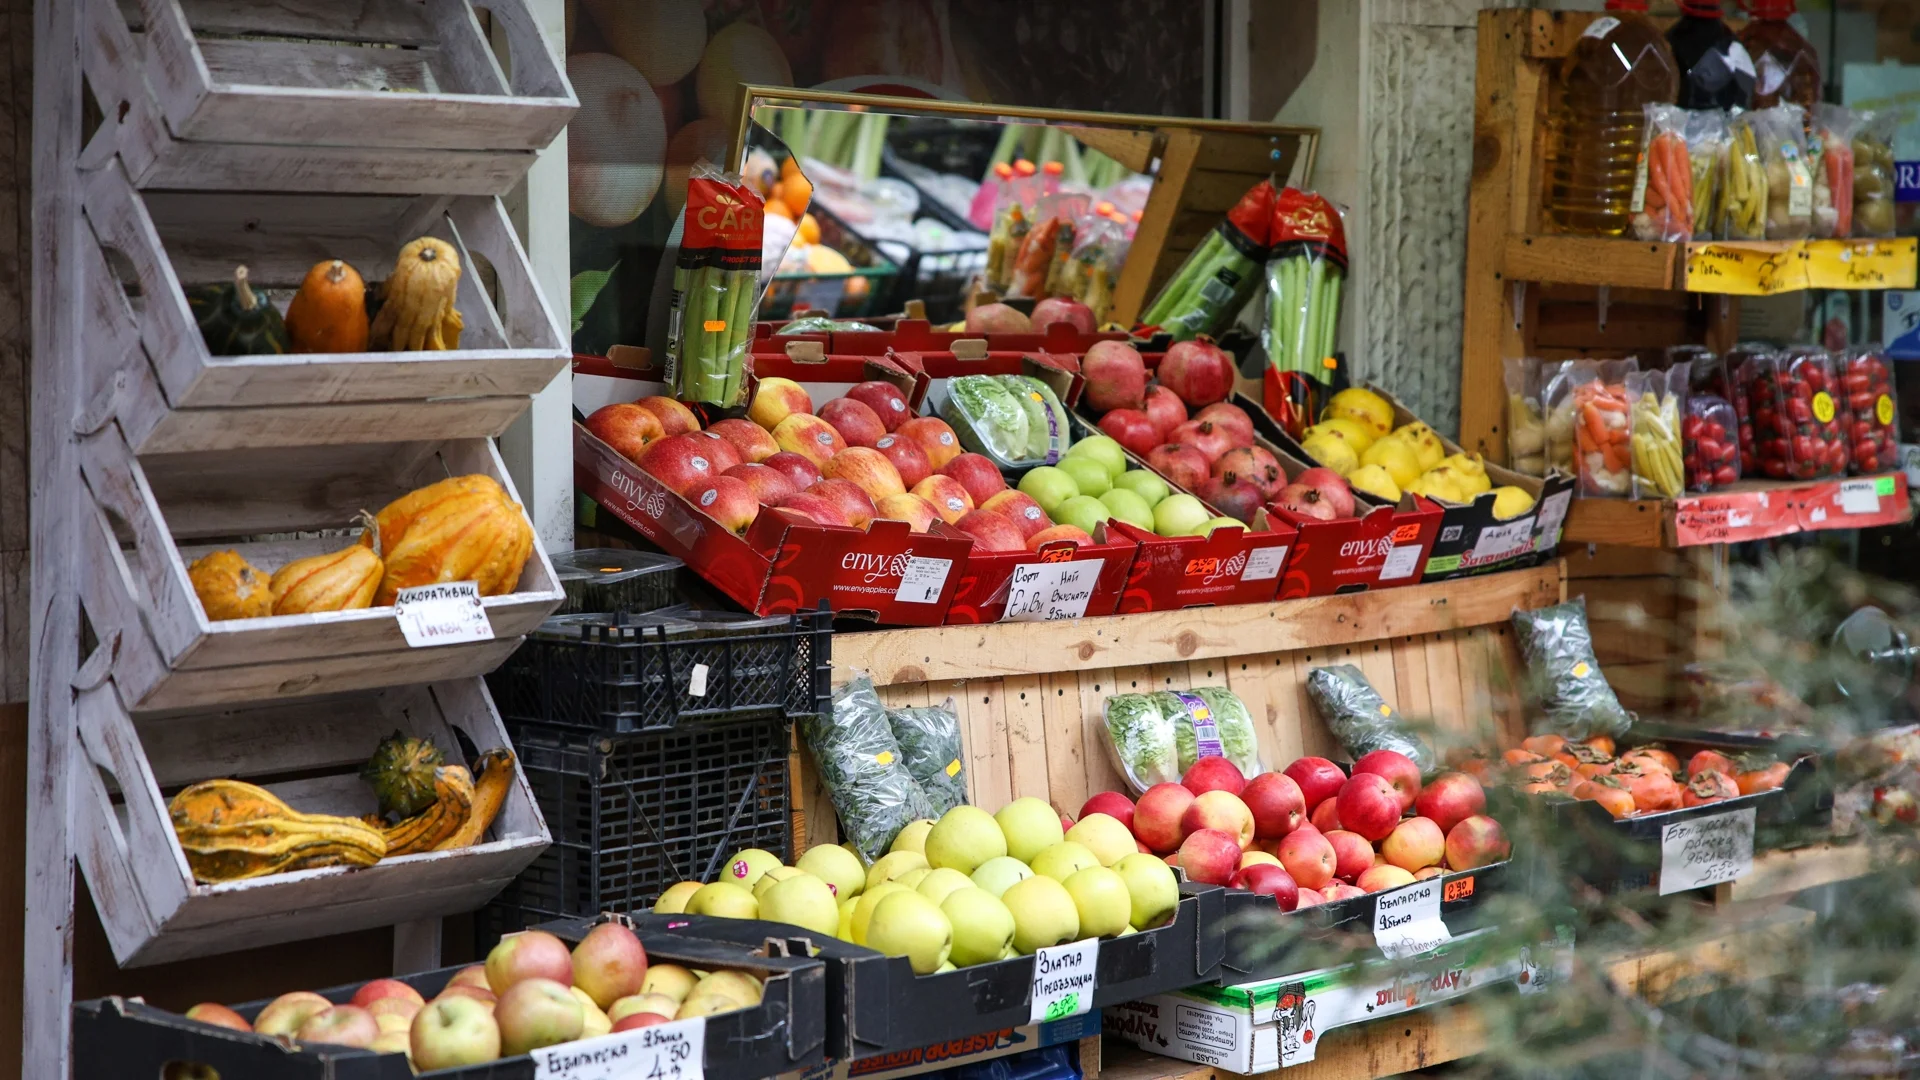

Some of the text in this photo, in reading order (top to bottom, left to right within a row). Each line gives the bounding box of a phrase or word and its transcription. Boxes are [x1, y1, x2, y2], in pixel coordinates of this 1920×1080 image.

[611, 470, 648, 511] envy
[603, 498, 656, 538] www.envyapples.com
[1340, 538, 1380, 565] envy
[841, 552, 892, 583] envy
[833, 584, 900, 595] www.envyapples.co
[1177, 584, 1236, 595] www.envyapples.com
[1196, 1052, 1219, 1065] CLASS
